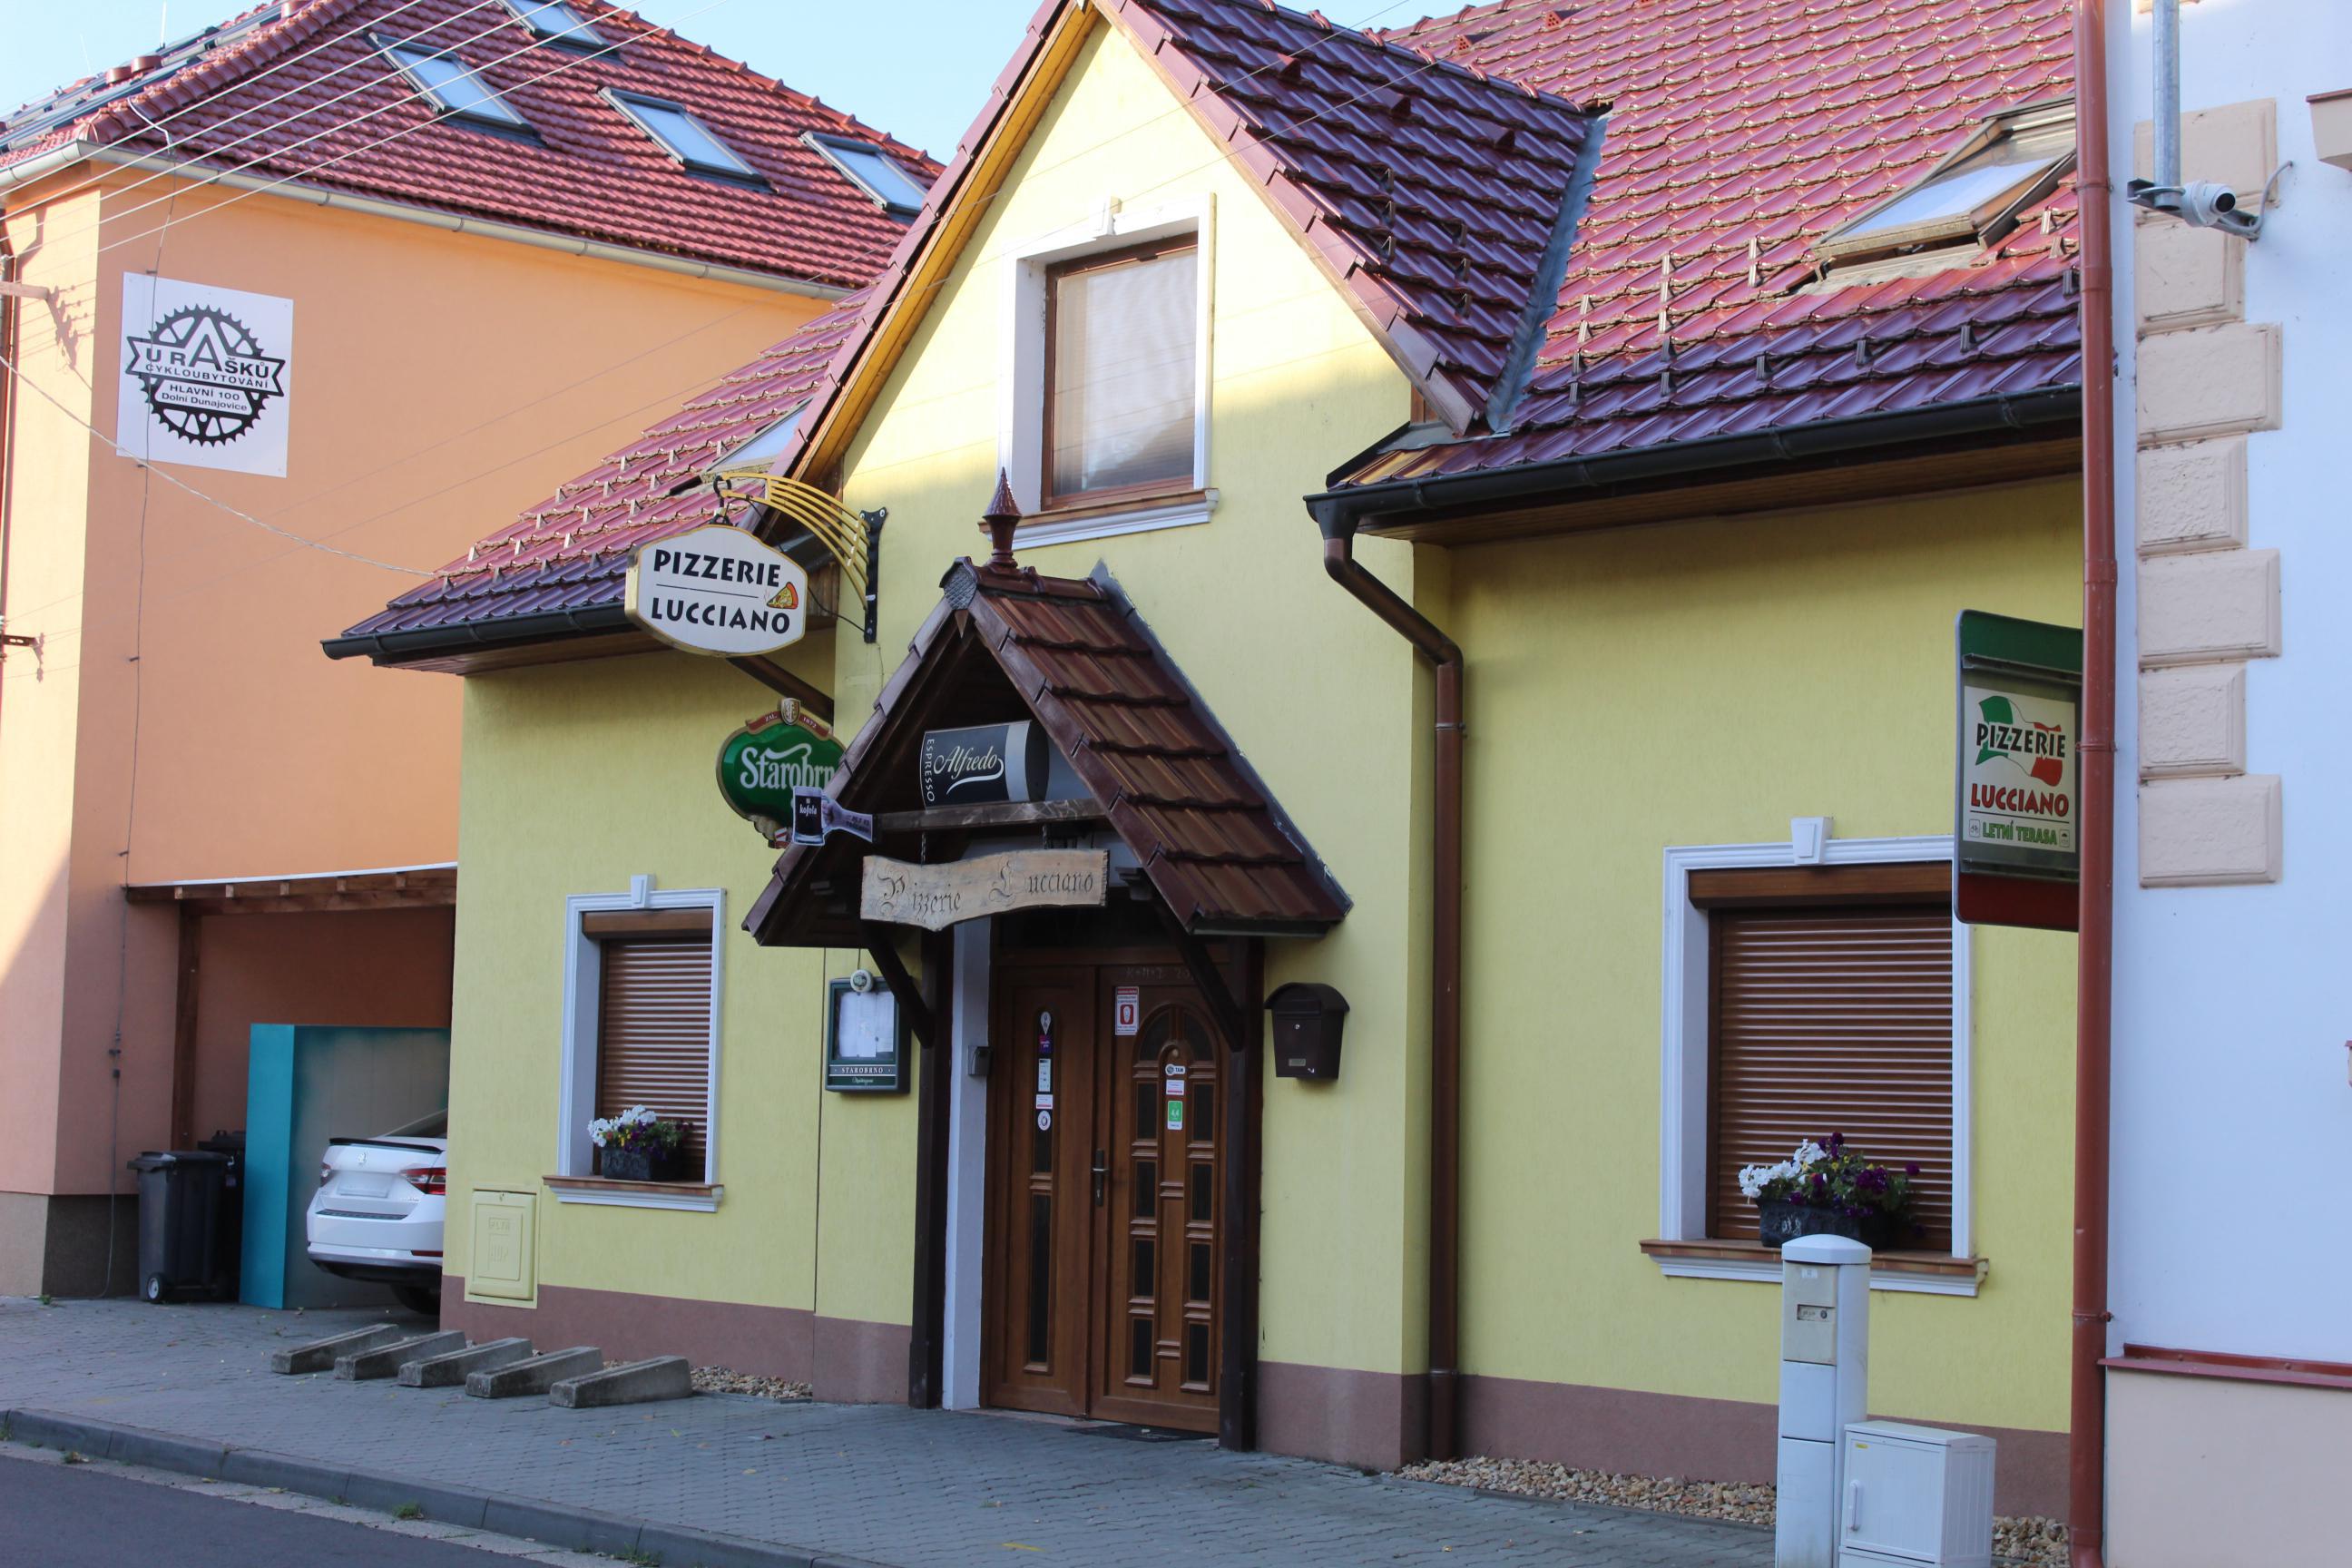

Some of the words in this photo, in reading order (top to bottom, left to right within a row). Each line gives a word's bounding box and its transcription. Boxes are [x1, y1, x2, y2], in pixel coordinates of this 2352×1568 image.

[145, 363, 269, 388] CYKLOUBYTOVÁNÍ
[170, 384, 214, 397] HLAVNÍ
[219, 391, 240, 401] 100
[162, 392, 188, 403] Dolní
[191, 397, 248, 411] Dunajovice
[653, 549, 781, 588] PIZZERIE
[651, 597, 790, 634] LUCCIANO
[1976, 722, 2067, 758] PIZZERIE
[740, 743, 836, 790] Starobrn
[924, 739, 936, 802] ESPRESSO
[933, 745, 998, 780] Alfredo
[799, 804, 818, 817] kofola
[1971, 783, 2070, 818] LUCCIANO
[1982, 819, 2014, 840] LETNÍ
[2015, 826, 2058, 846] TERASA
[877, 872, 962, 923] Pizzerie
[988, 860, 1094, 907] Lucciano
[841, 1065, 884, 1074] STAROBRNO
